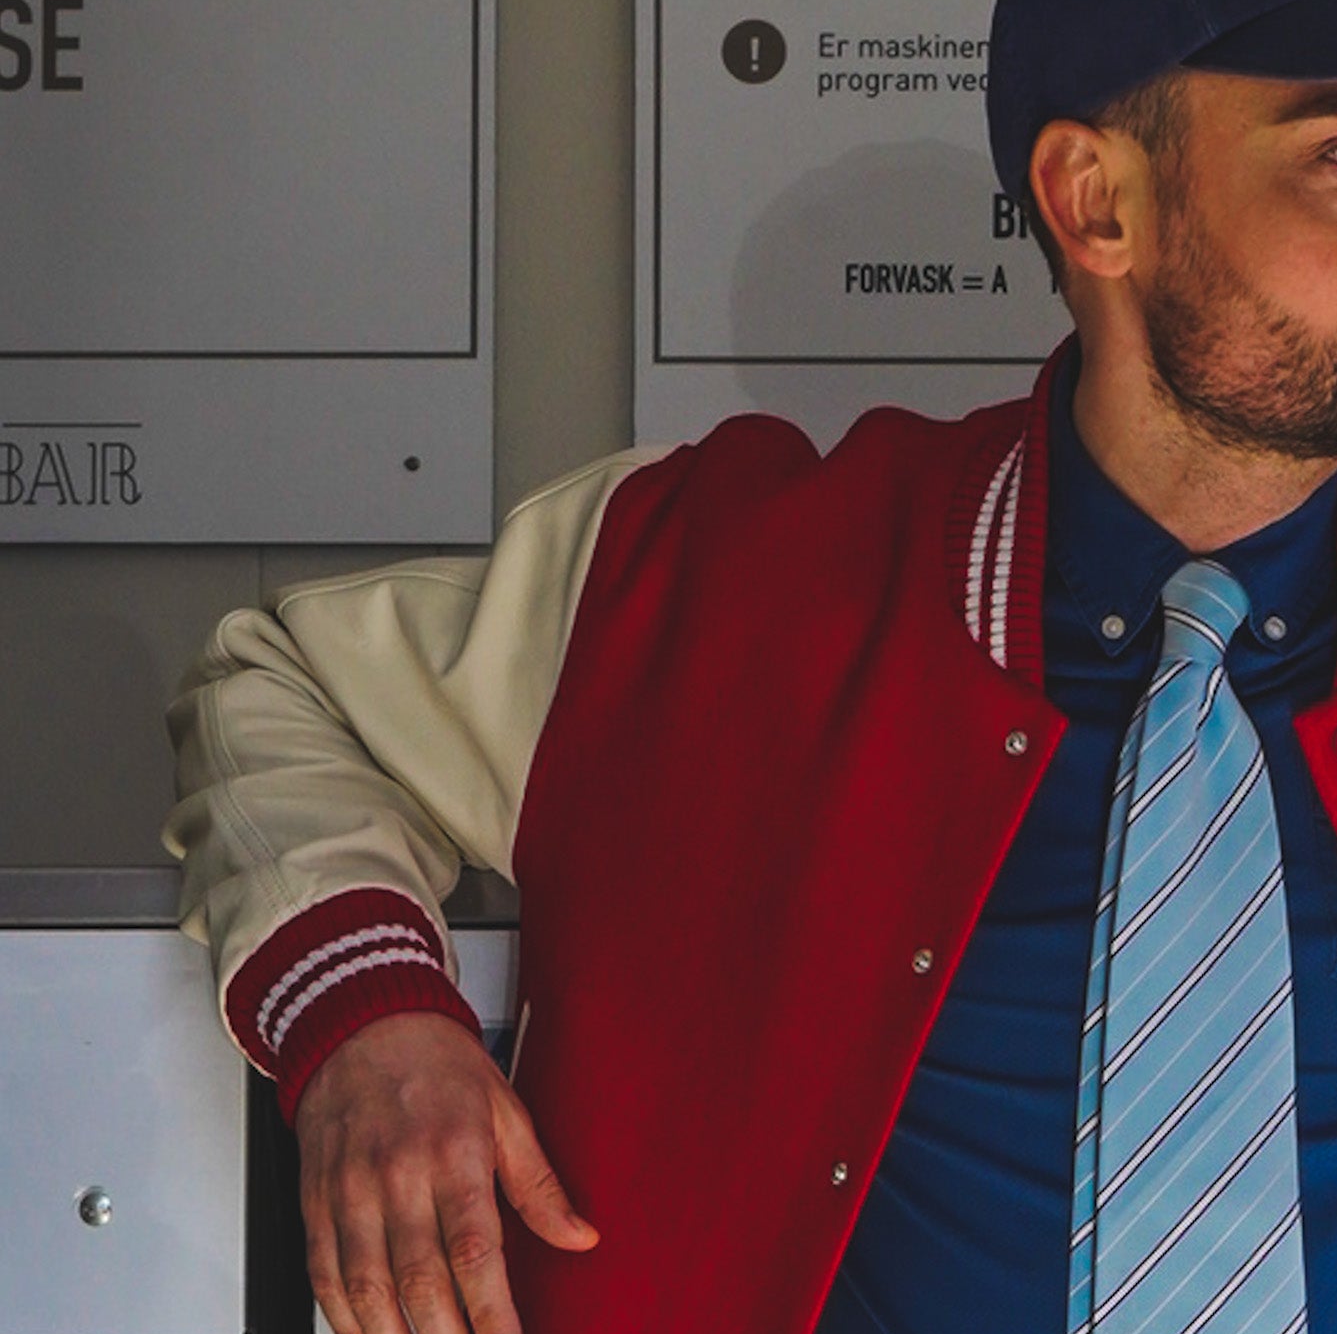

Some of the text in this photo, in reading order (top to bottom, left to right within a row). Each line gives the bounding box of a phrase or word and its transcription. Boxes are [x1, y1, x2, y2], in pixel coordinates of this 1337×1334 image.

[818, 32, 850, 59] Er
[817, 72, 938, 99] program
[845, 263, 955, 294] FORVASK
[991, 264, 1008, 294] A
